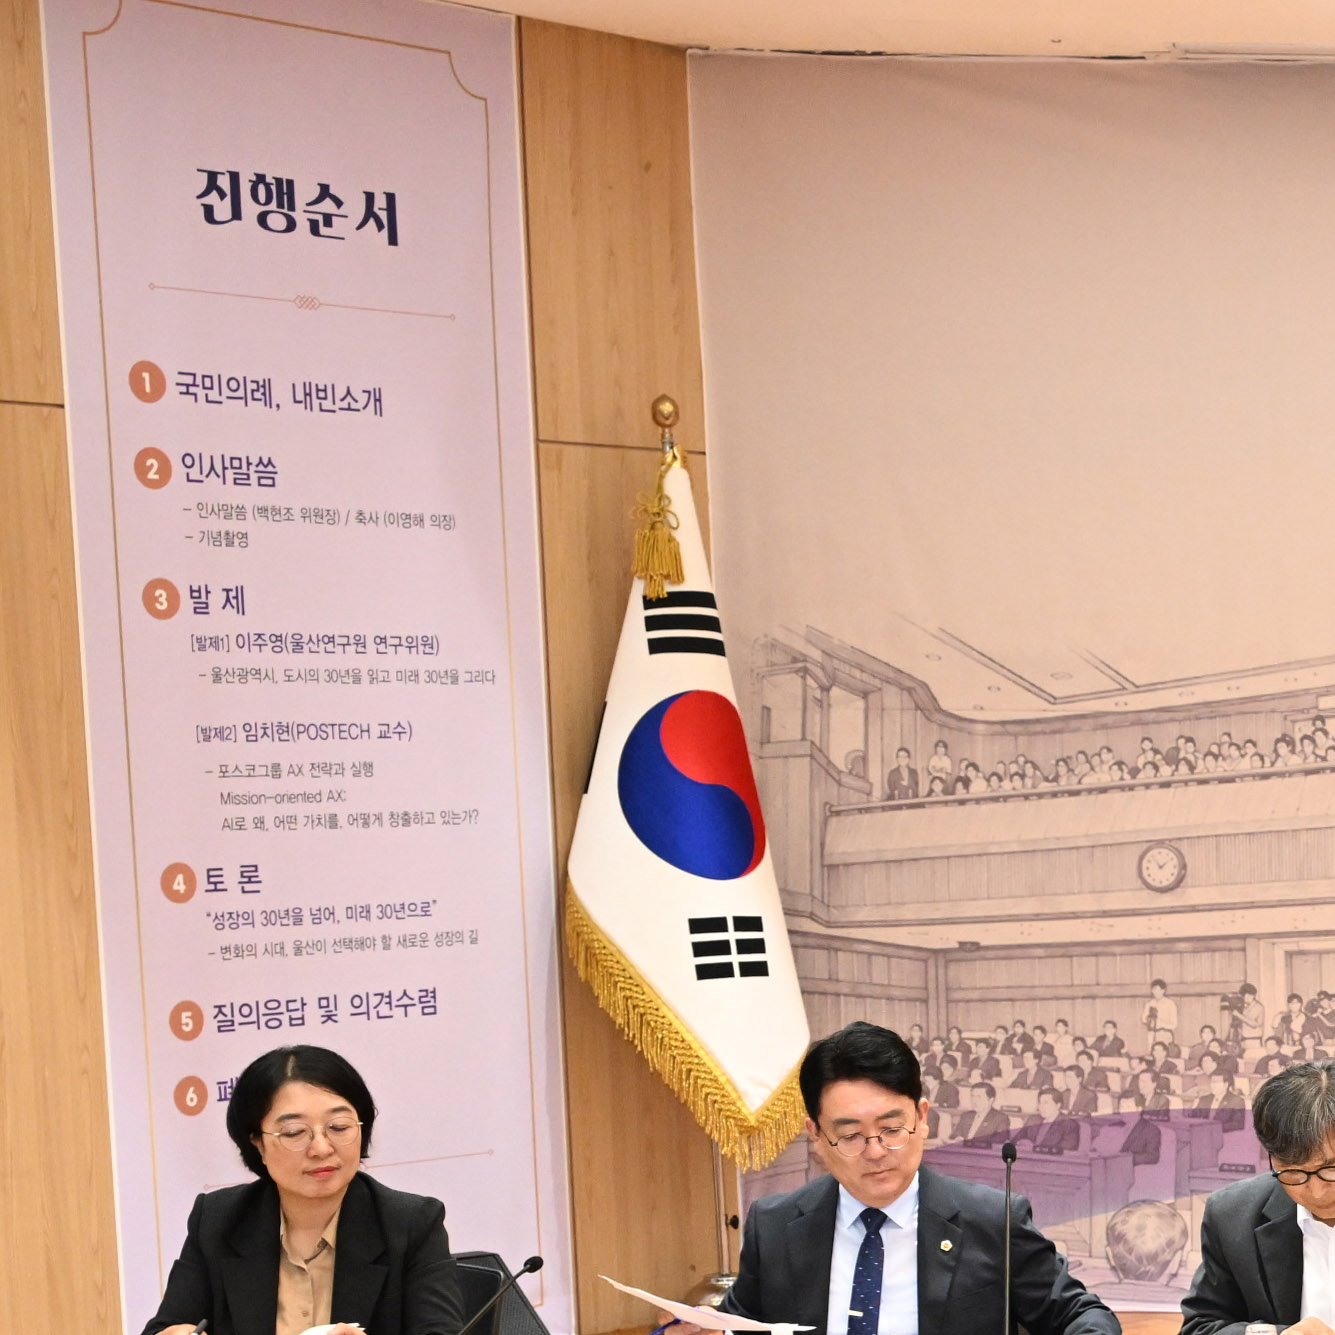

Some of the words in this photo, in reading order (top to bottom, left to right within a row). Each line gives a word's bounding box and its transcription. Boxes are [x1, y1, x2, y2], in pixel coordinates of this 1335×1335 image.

[196, 168, 399, 247] 진행순서
[175, 371, 281, 411] 국민의례,
[291, 381, 383, 417] 내빈소개
[181, 452, 278, 488] 인사말씀
[196, 502, 247, 521] 인사말씀
[252, 504, 294, 523] (백현조
[300, 507, 340, 525] 위원장)
[355, 510, 379, 525] 축사
[383, 511, 424, 529] (이영해
[430, 514, 455, 531] 의장)
[199, 530, 248, 548] 기념촬영
[235, 632, 368, 655] 이주영(울산연구원
[373, 634, 440, 656] 연구위원)
[211, 667, 278, 684] 울산광역시,
[284, 668, 319, 684] 도시의
[324, 669, 362, 685] 30년을
[368, 669, 391, 685] 읽고
[396, 669, 419, 685] 미래
[424, 669, 459, 685] 30년을
[464, 670, 495, 685] 그리다
[242, 721, 370, 743] 임치현(POSTECH
[377, 720, 412, 742] 교수)
[218, 763, 281, 779] 포스코그룹
[287, 764, 303, 776] AX
[309, 762, 345, 777] 전략과
[350, 761, 374, 777] 실행
[220, 790, 322, 805] Mission-oriented
[274, 815, 297, 831] 어떤
[303, 814, 342, 831] 가치를,
[348, 812, 383, 828] 어떻게
[388, 811, 435, 826] 창출하고
[440, 809, 479, 825] 있는가?
[260, 907, 303, 927] 30년을
[310, 906, 340, 925] 넘어,
[345, 904, 371, 922] 미래
[220, 943, 257, 961] 변화의
[263, 941, 288, 957] 시대,
[293, 938, 326, 956] 울산이
[331, 936, 376, 953] 선택해야
[381, 934, 392, 951] 할
[397, 932, 429, 949] 새로운
[434, 930, 464, 946] 성장의
[469, 929, 479, 945] 길
[213, 997, 307, 1033] 질의응답
[318, 995, 338, 1024] 및
[350, 986, 438, 1021] 의견수렴
